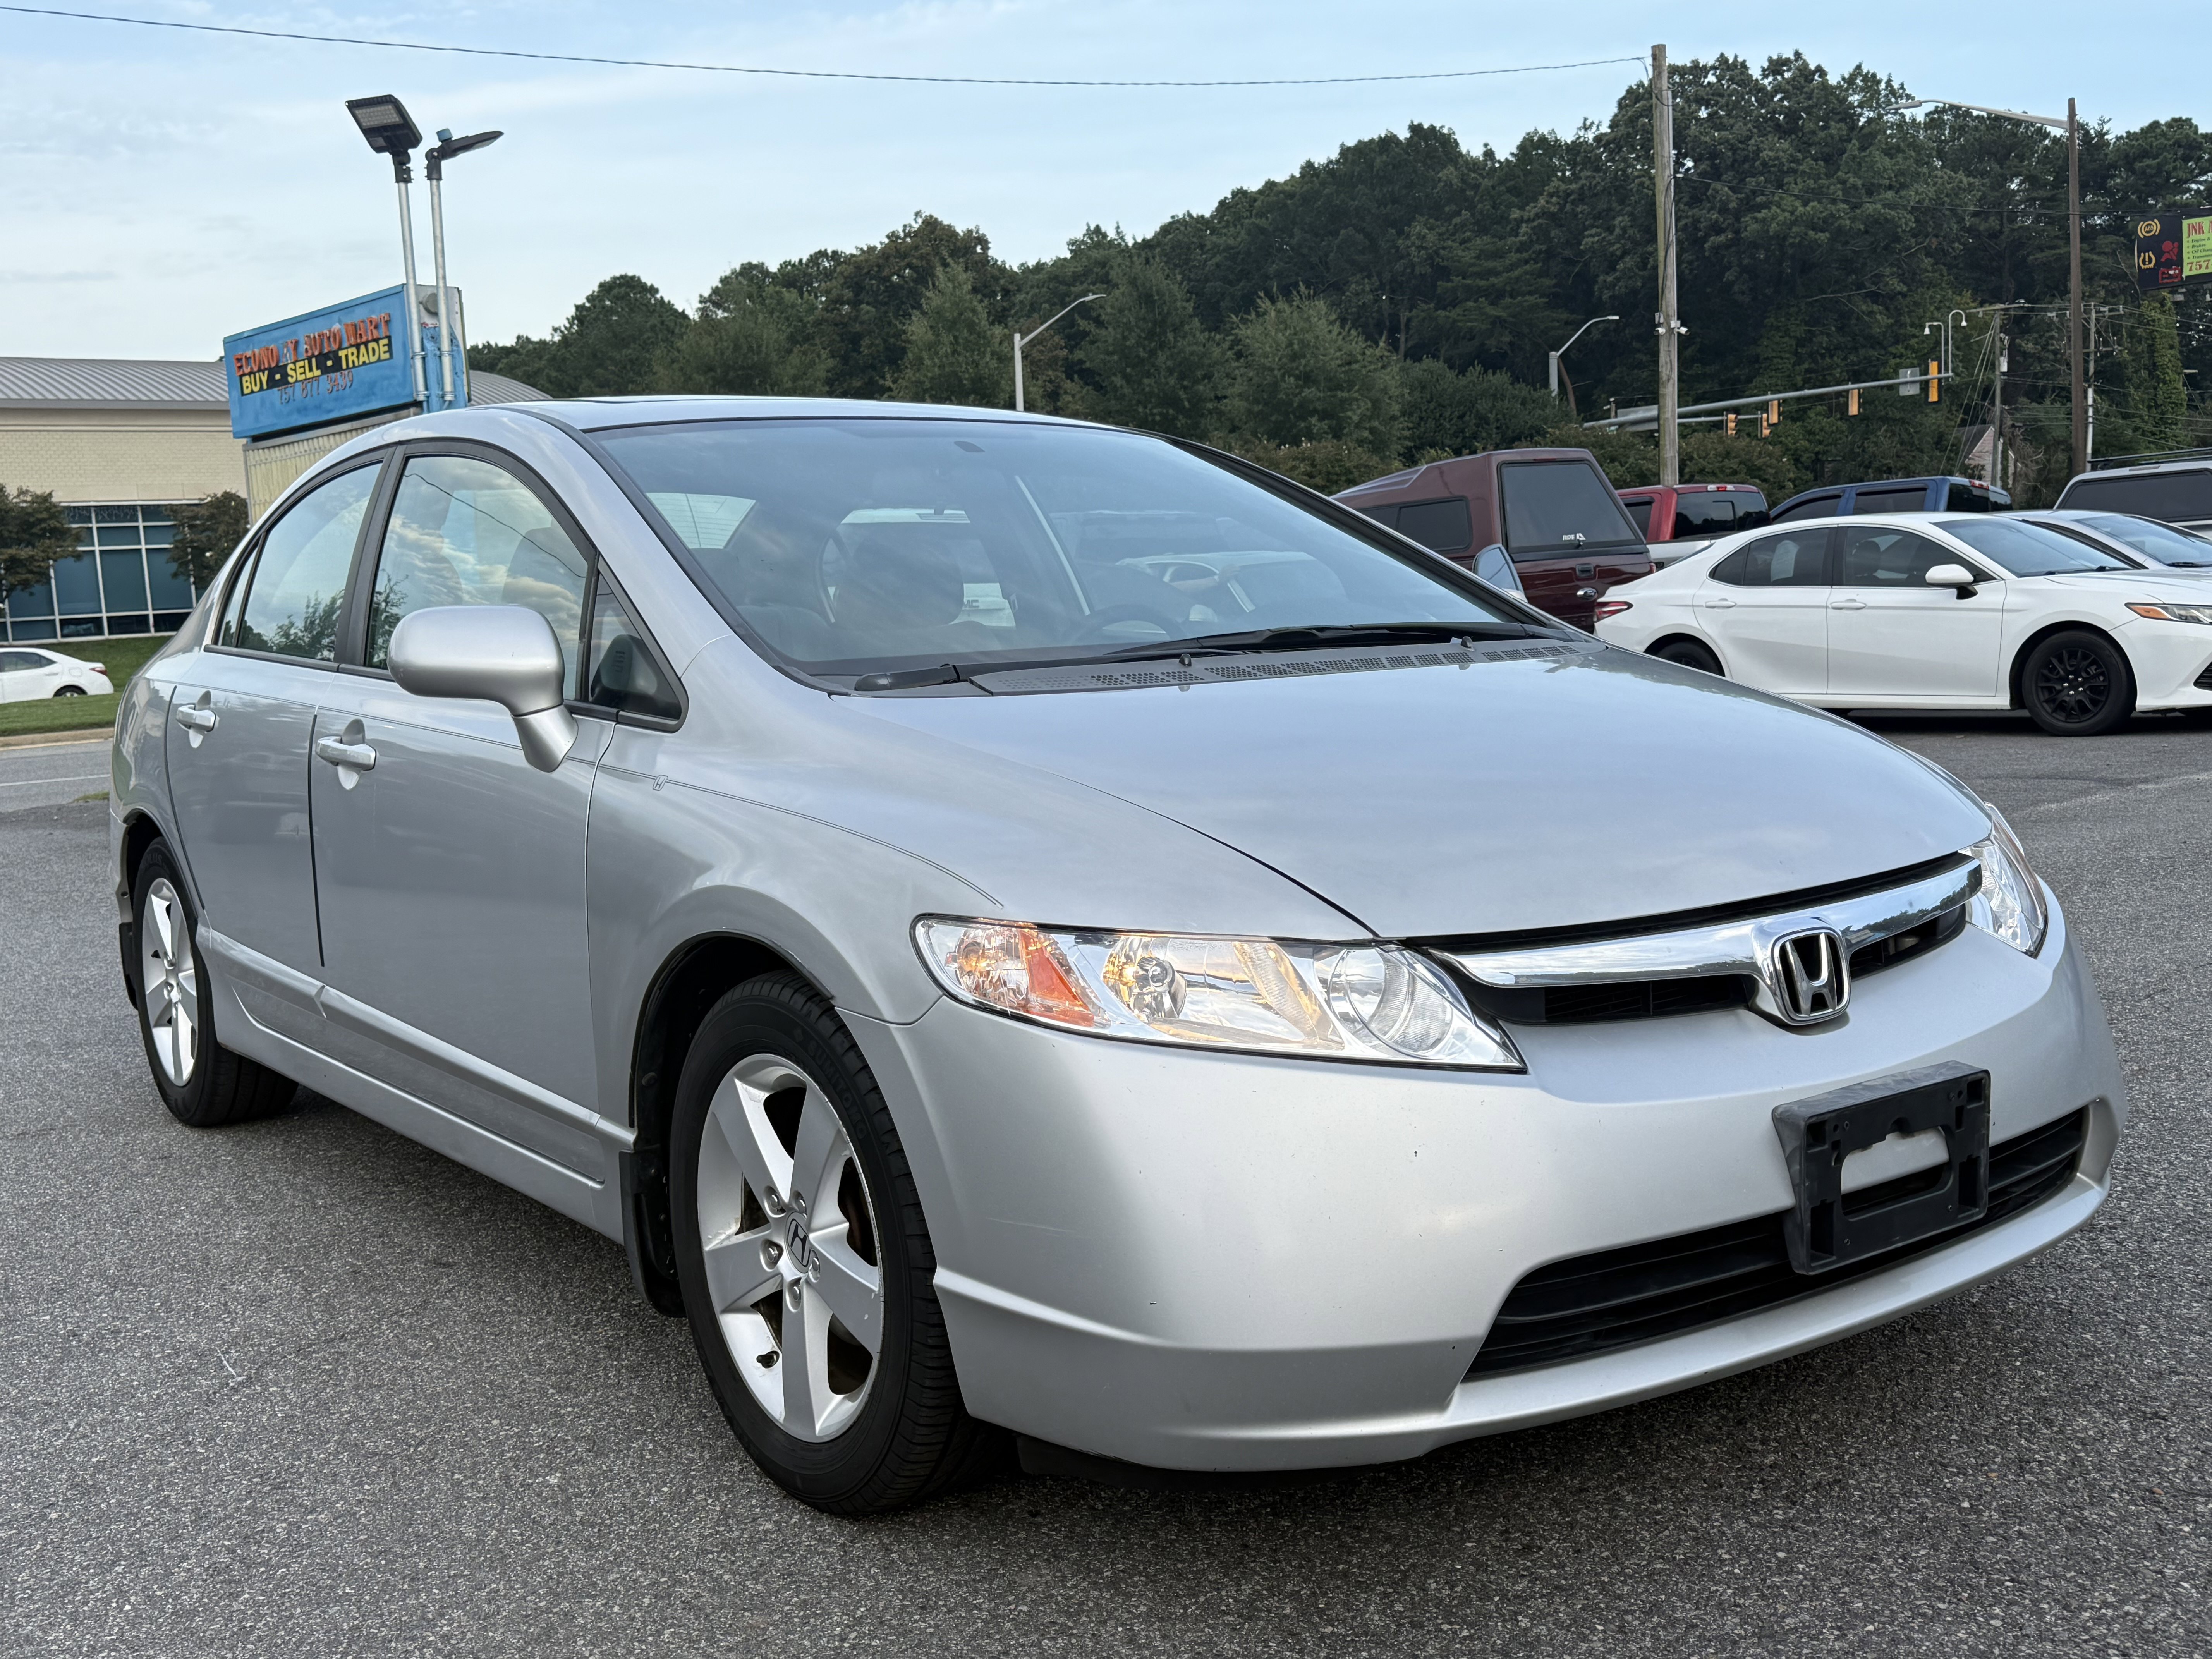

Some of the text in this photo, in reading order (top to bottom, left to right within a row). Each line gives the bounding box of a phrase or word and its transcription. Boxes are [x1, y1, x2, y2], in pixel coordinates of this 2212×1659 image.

[2187, 222, 2205, 238] JNK
[304, 326, 342, 357] AUTO
[343, 313, 391, 346] MART
[242, 338, 390, 394] BUY SELL TRADE
[807, 1040, 867, 1139] SUMITOMO
